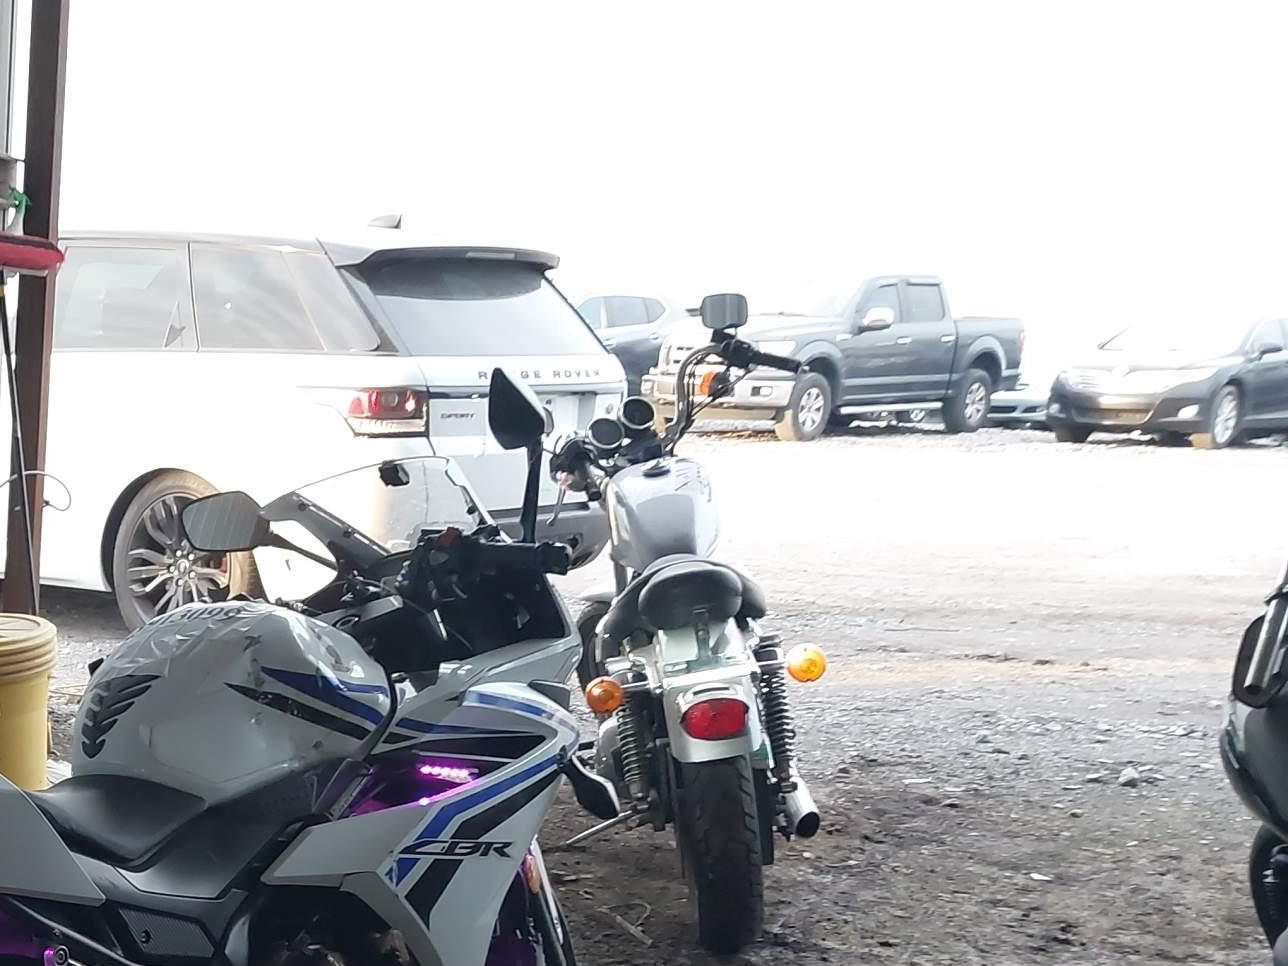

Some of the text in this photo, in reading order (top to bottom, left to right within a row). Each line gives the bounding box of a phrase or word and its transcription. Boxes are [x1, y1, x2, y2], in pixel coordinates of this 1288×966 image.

[478, 368, 600, 380] RGE ROVER
[398, 839, 514, 858] CBR
